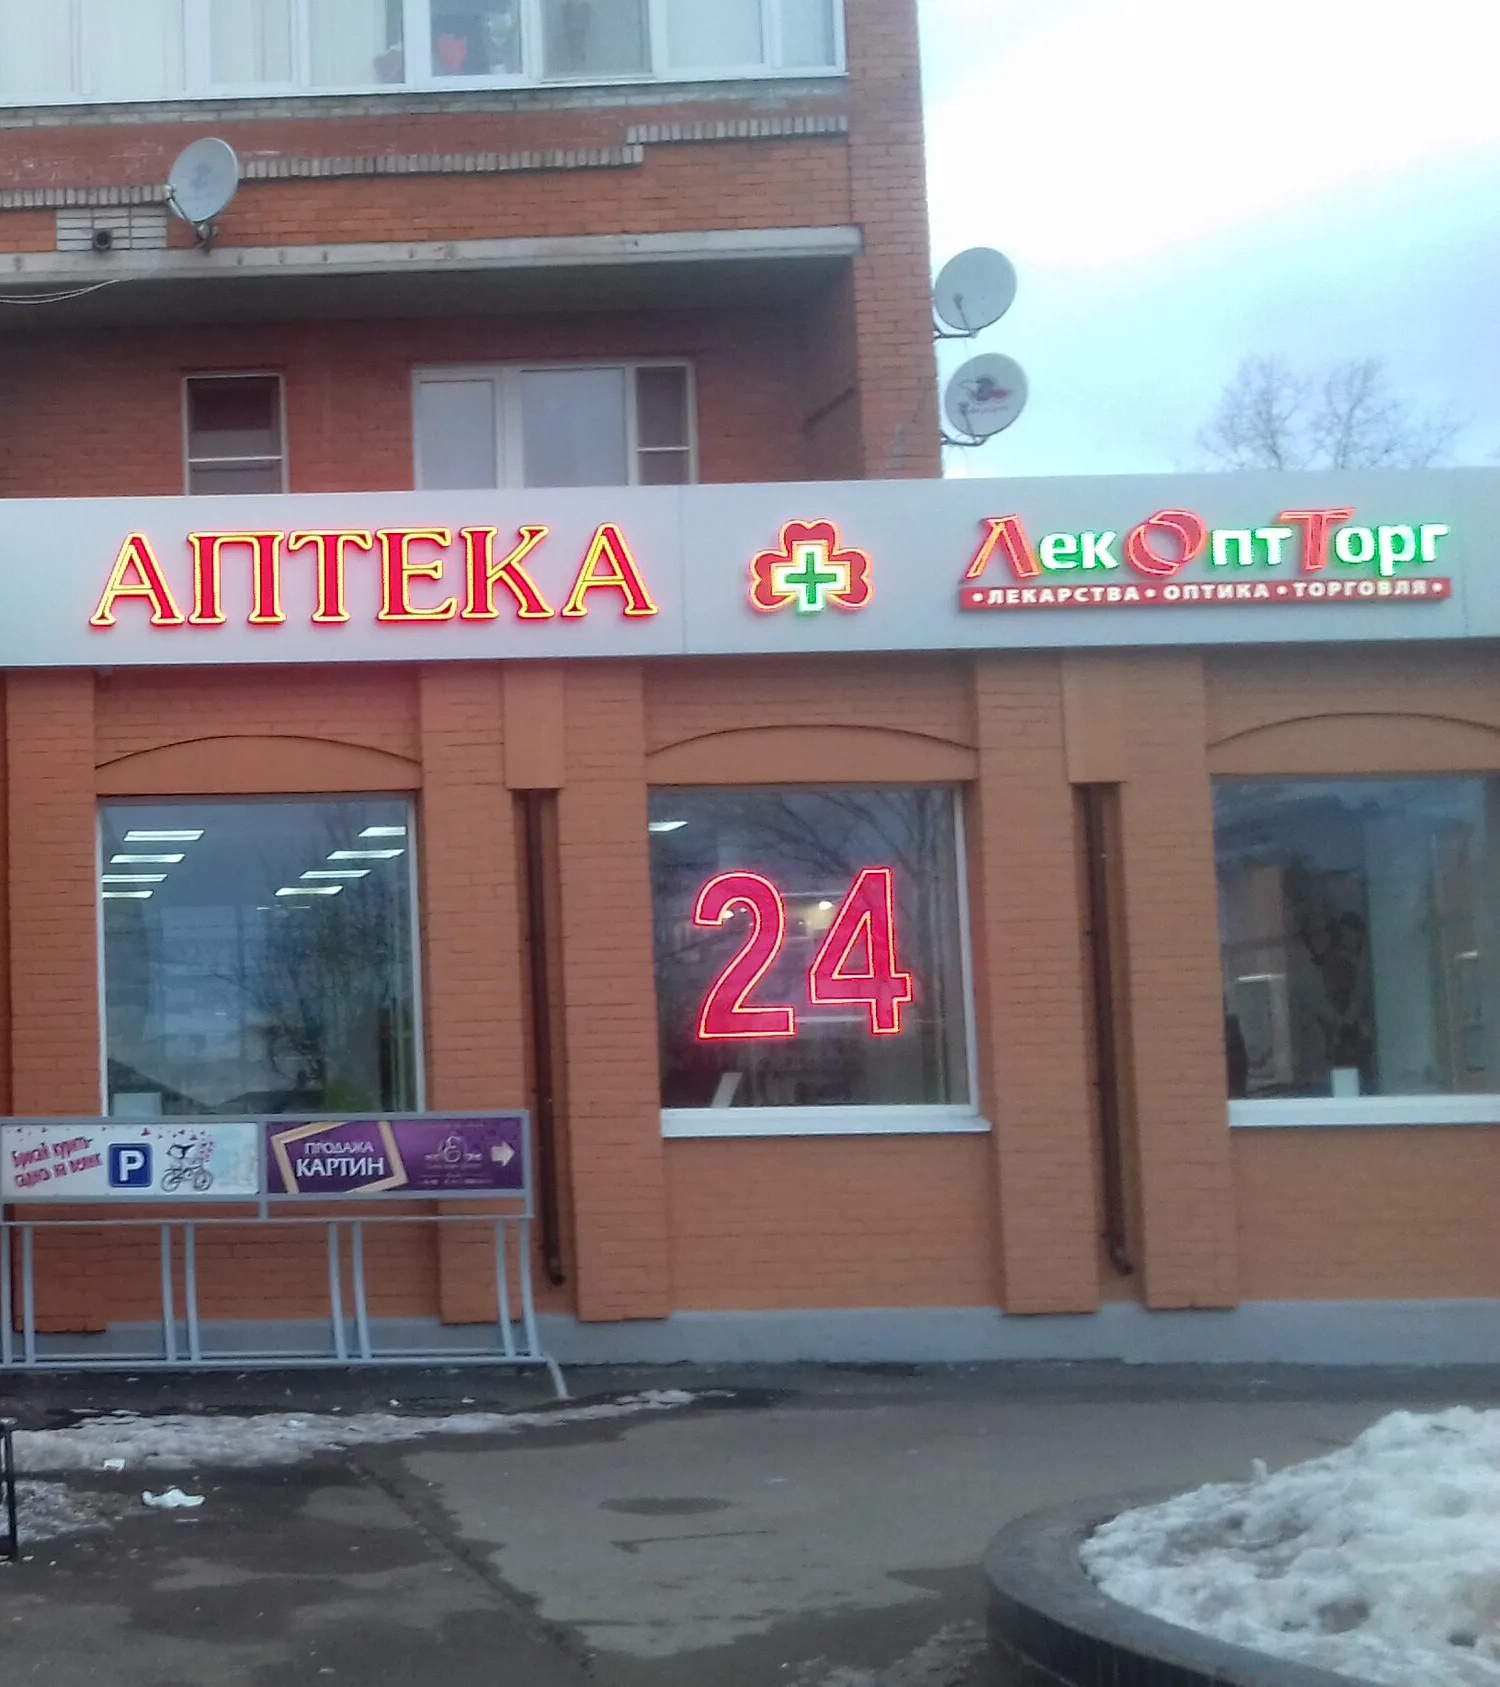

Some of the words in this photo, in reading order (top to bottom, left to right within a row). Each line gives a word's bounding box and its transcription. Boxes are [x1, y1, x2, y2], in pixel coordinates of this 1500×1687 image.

[89, 522, 658, 626] АПТЕКА
[987, 585, 1140, 606] ЛЕКАРСТВА
[1162, 581, 1271, 601] ОПТИКА
[1292, 578, 1428, 598] ТОРГОВЛЯ
[693, 867, 914, 1039] 24
[304, 1140, 375, 1155] ПРОДАЖА
[119, 1149, 145, 1182] P
[295, 1157, 385, 1178] КАРТИН
